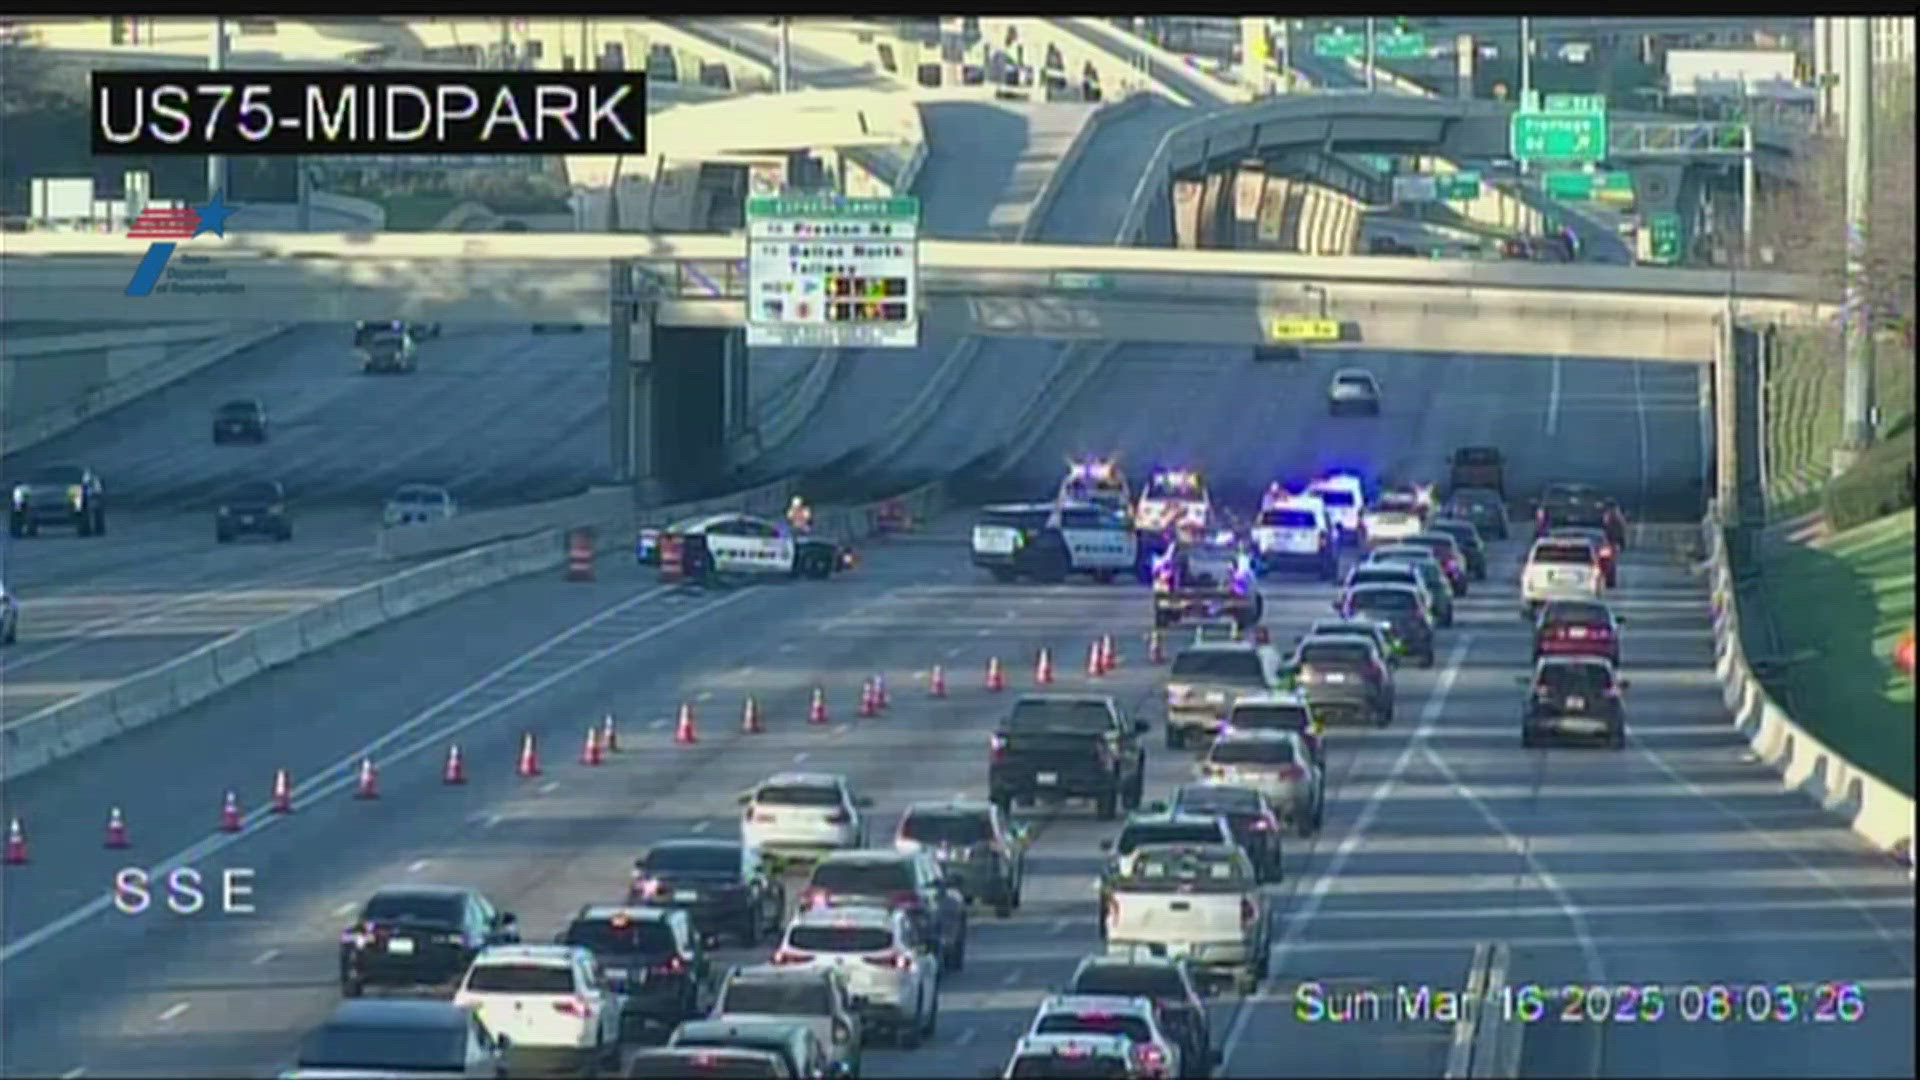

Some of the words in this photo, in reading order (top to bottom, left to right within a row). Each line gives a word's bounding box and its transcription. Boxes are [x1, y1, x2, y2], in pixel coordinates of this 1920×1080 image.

[794, 223, 861, 234] Preston
[789, 245, 843, 257] Dallas
[853, 245, 904, 257] North
[715, 548, 778, 560] POLICE
[1074, 543, 1124, 554] POLICE
